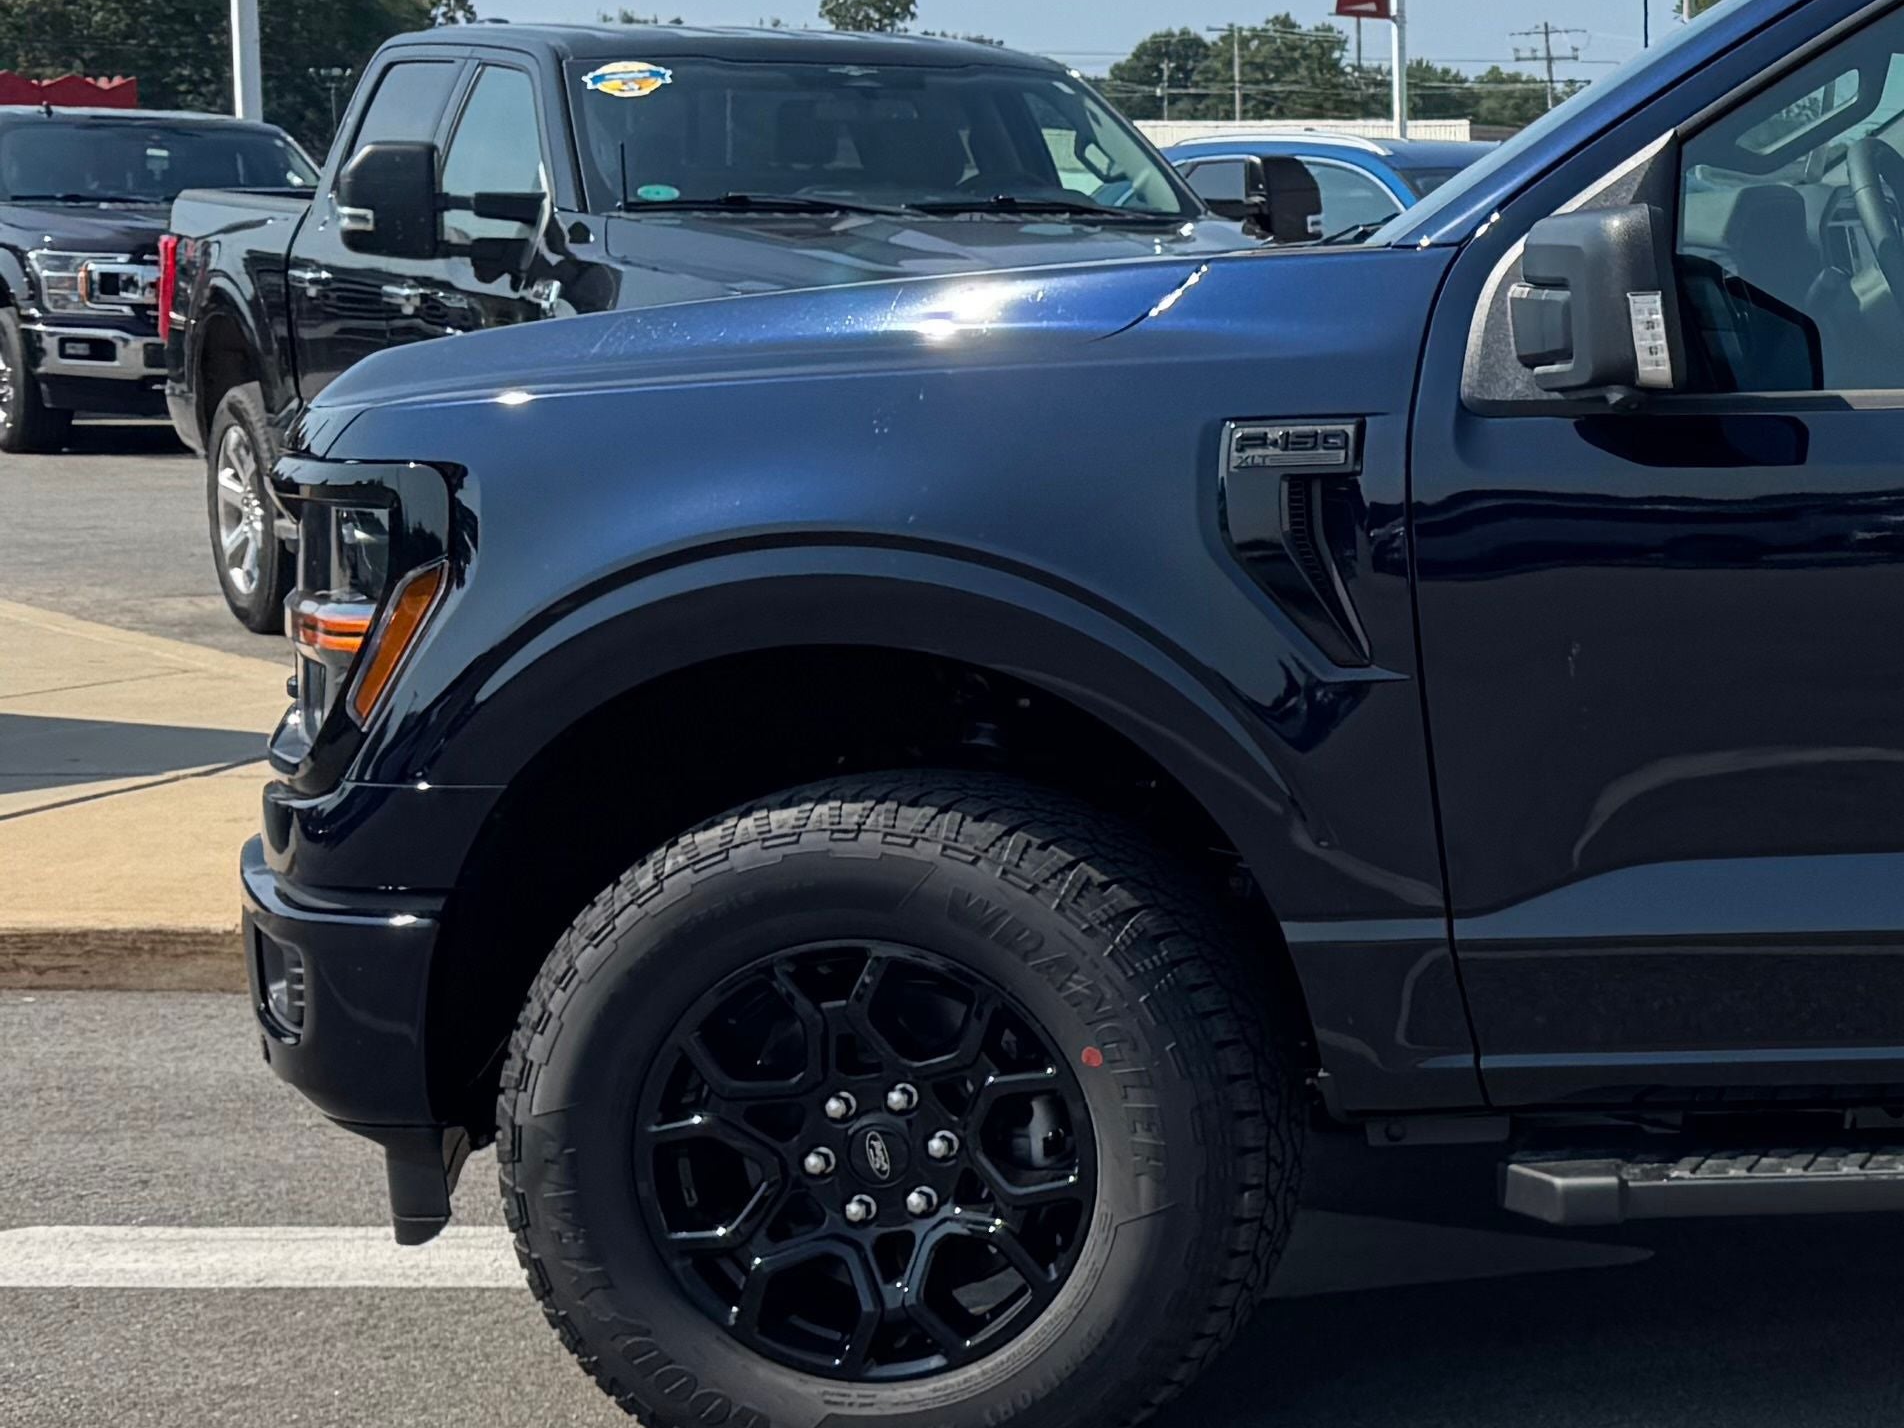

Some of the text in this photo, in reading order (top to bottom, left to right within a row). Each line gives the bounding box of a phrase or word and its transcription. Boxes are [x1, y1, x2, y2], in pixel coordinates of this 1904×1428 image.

[1235, 430, 1349, 453] F-150
[1237, 454, 1267, 466] XLT
[945, 886, 1167, 1181] WRANGLER
